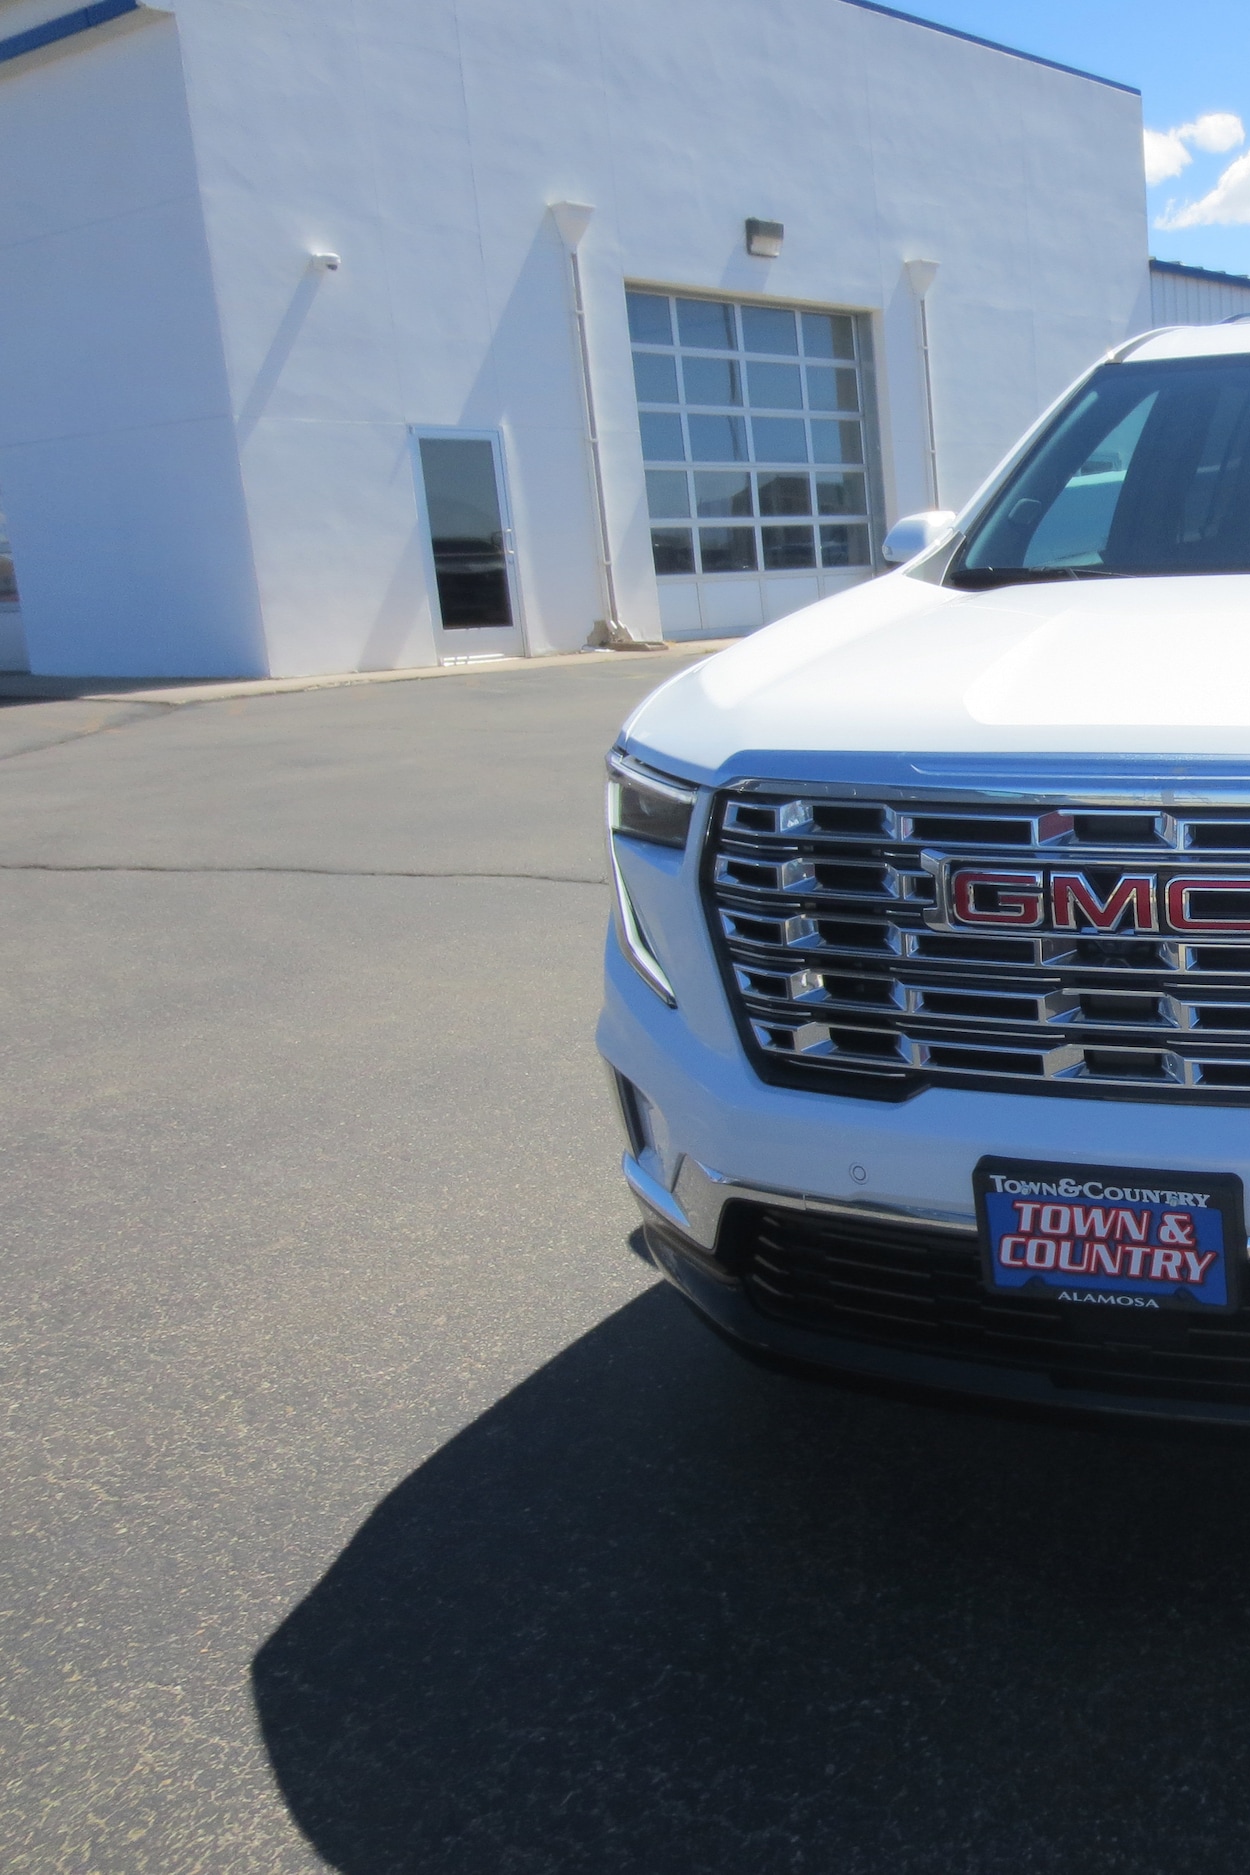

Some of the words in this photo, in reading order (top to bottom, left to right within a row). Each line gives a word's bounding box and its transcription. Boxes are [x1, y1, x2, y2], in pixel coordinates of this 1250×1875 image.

[1013, 1201, 1150, 1243] TOWN
[1158, 1212, 1196, 1247] &
[1000, 1235, 1216, 1283] COUNTRY
[1058, 1291, 1159, 1308] ALAMOSA
